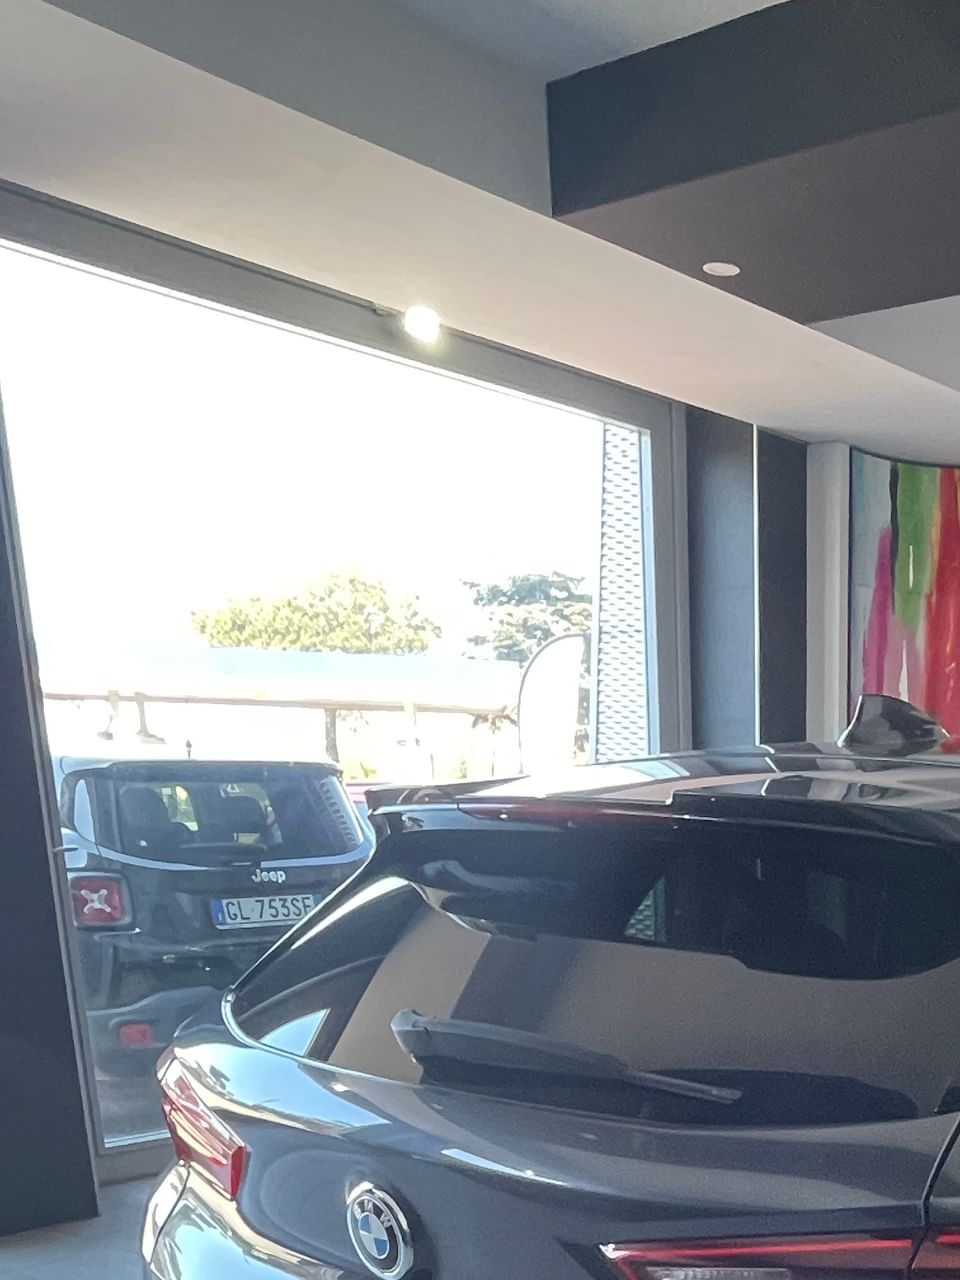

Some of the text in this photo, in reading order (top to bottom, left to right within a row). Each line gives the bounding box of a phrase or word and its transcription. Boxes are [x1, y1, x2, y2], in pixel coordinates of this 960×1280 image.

[251, 868, 286, 883] Jeep
[225, 901, 250, 921] GL
[352, 1198, 393, 1229] BMW
